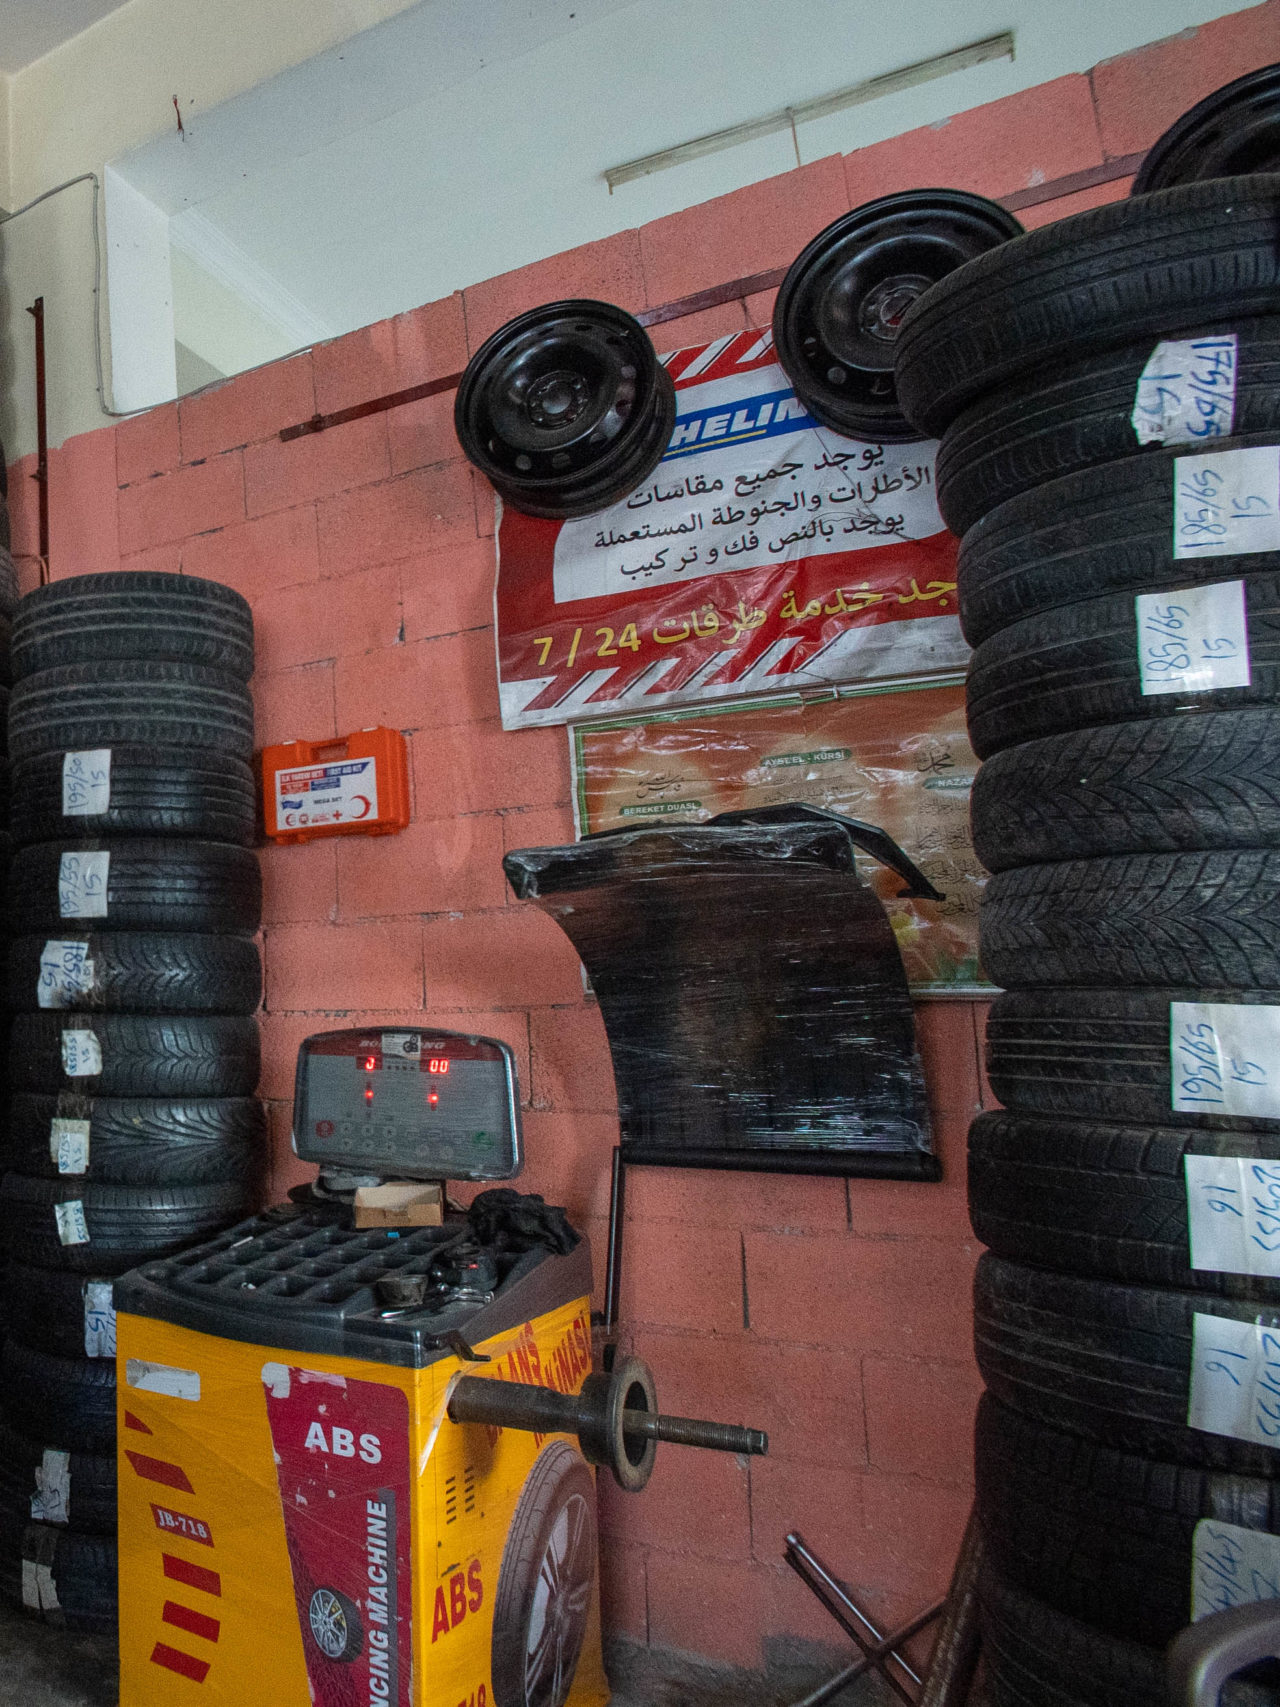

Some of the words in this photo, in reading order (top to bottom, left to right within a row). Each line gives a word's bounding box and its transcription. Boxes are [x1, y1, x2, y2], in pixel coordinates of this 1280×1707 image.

[1138, 374, 1183, 415] 15
[1186, 341, 1234, 437] 175/65
[669, 397, 807, 448] HELIN
[813, 444, 884, 472] يوجد
[625, 475, 724, 511] مقاسات
[734, 458, 803, 497] جميع
[842, 511, 905, 535] يوجد
[1179, 469, 1227, 548] 185/65
[1230, 495, 1273, 518] 15
[594, 512, 703, 550] المستعملة
[724, 530, 760, 557] فك
[779, 580, 882, 620] خدمة
[898, 577, 958, 606] جد
[533, 635, 555, 666] 7
[566, 627, 582, 668] /
[595, 622, 641, 658] 24
[1145, 605, 1191, 682] 185/65
[1199, 638, 1238, 659] 15
[623, 803, 665, 816] BEREKET
[83, 873, 103, 897] 15
[41, 960, 60, 988] 15
[1179, 1022, 1224, 1104] 195/65
[1229, 1058, 1268, 1086] 15
[304, 1421, 382, 1465] ABS
[157, 1508, 208, 1539] JB-718
[366, 1500, 389, 1626] MACHINE
[431, 1559, 483, 1645] ABS
[369, 1630, 389, 1707] NCING
